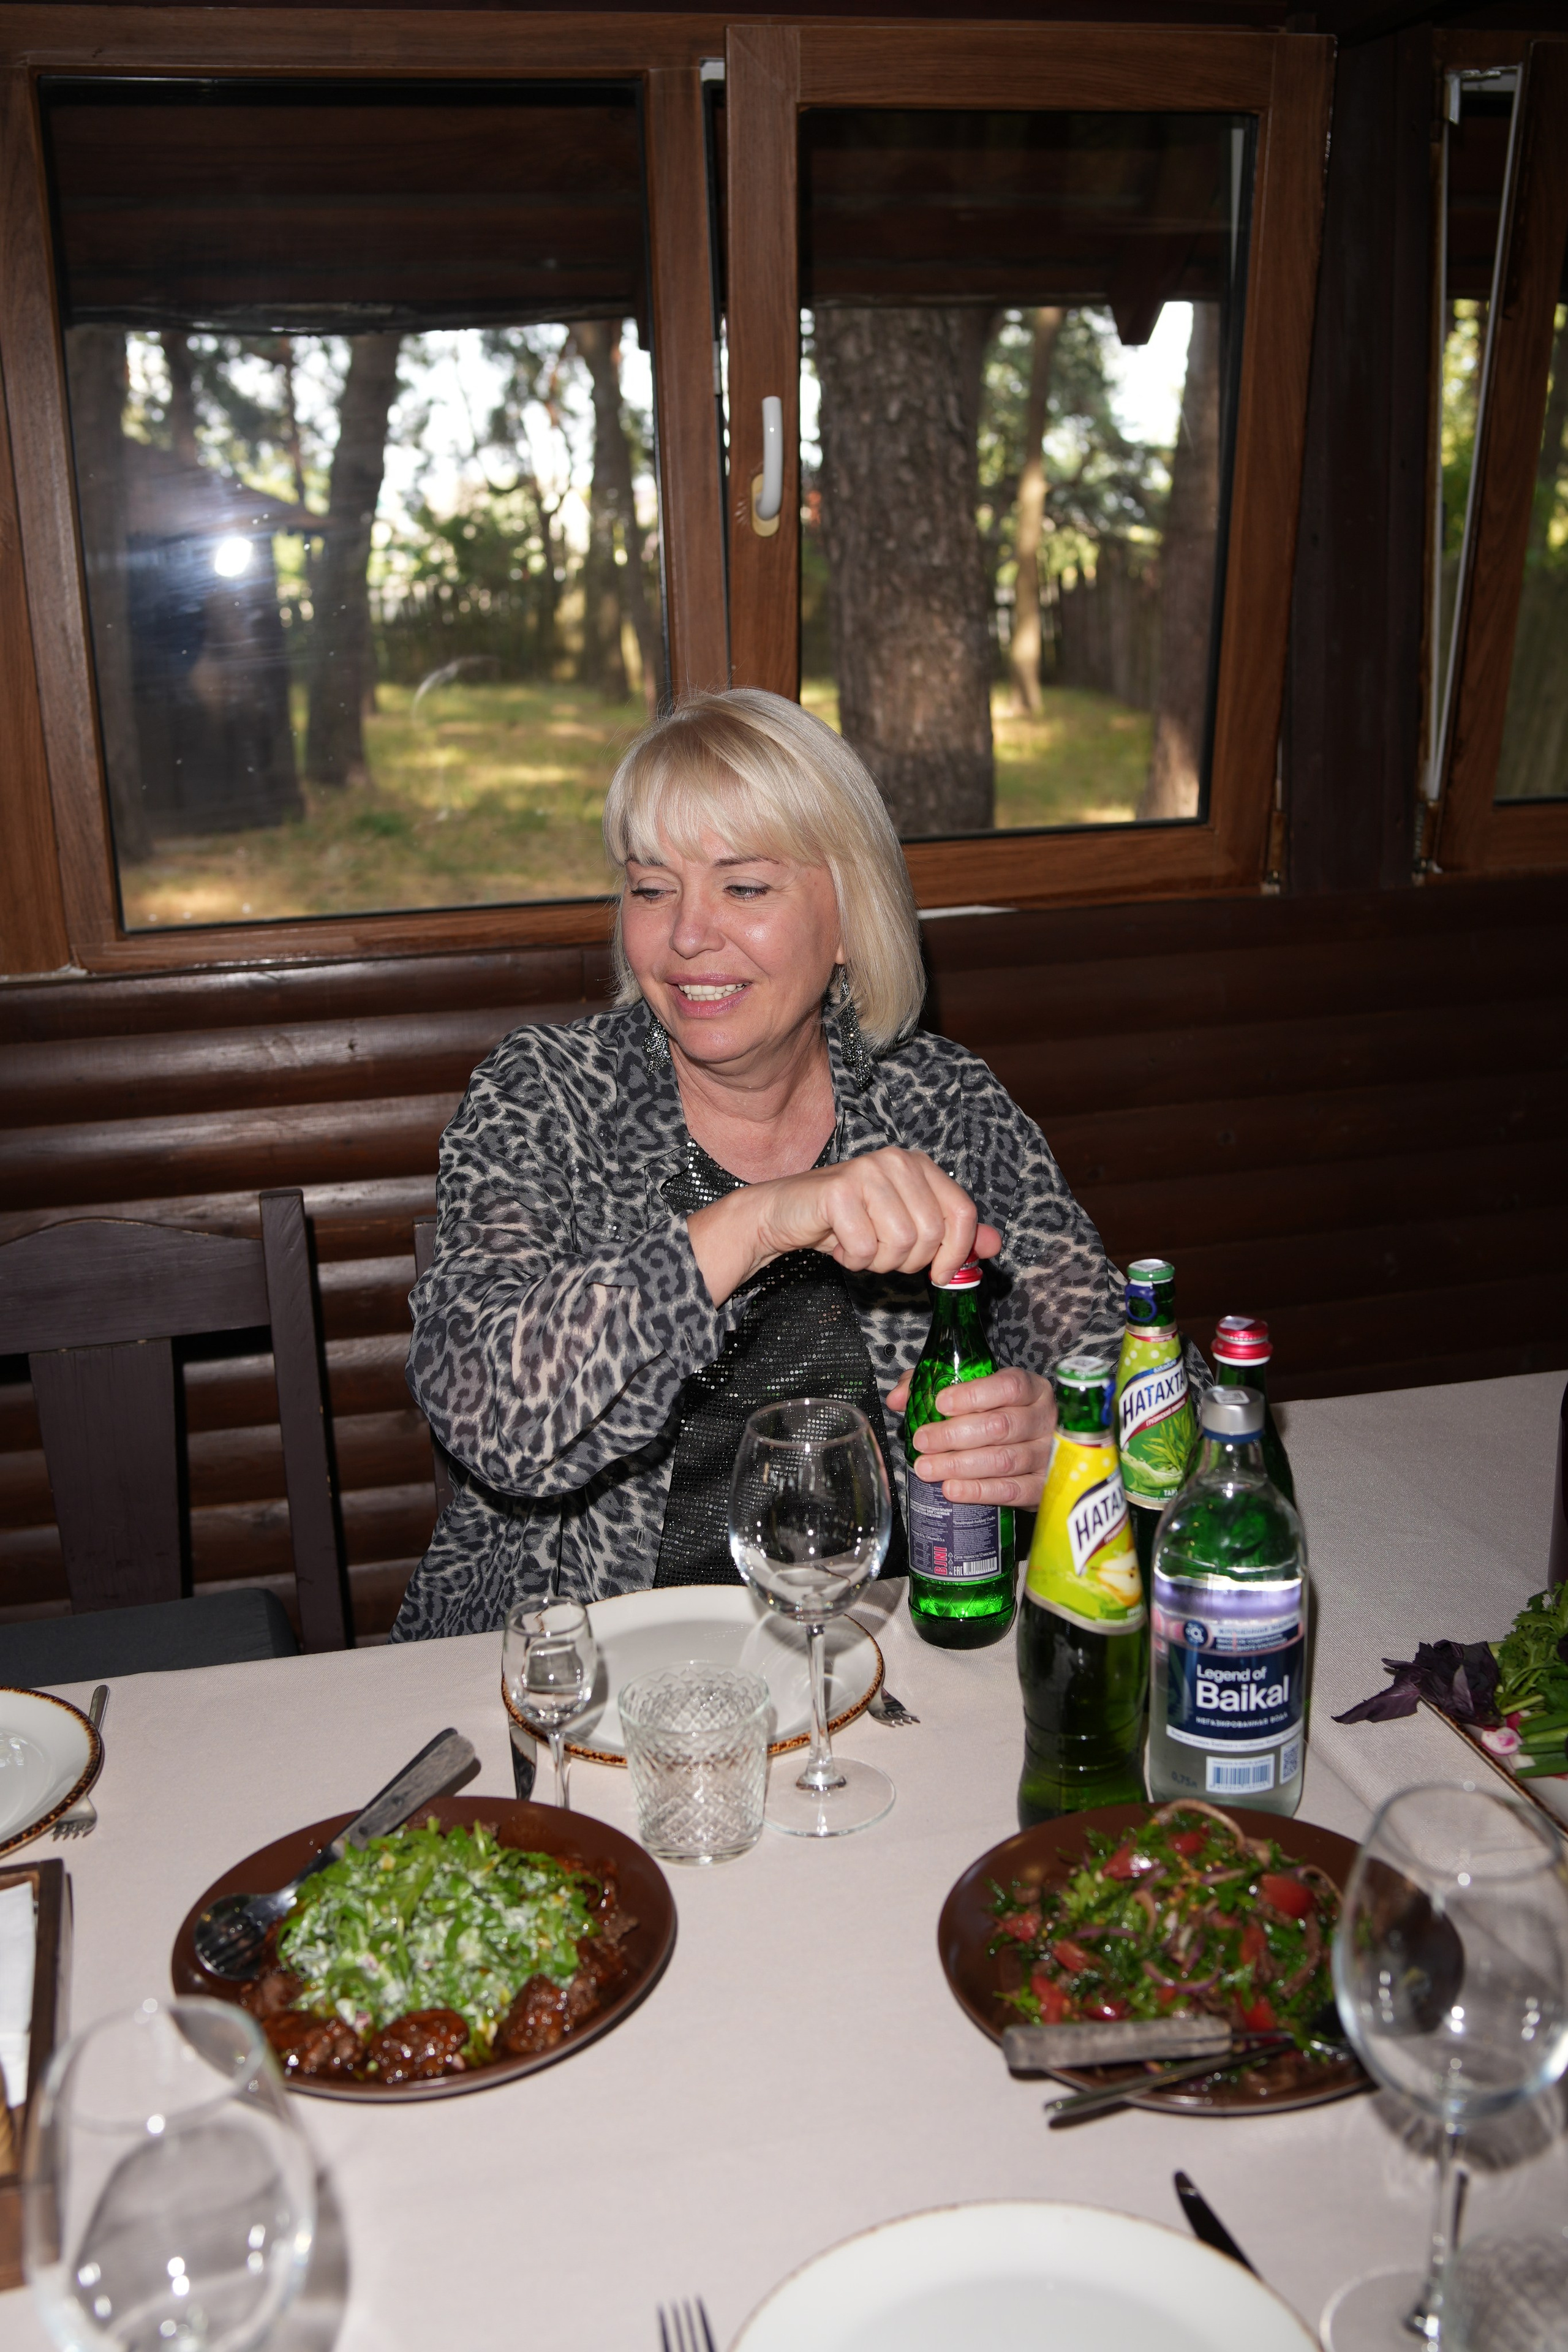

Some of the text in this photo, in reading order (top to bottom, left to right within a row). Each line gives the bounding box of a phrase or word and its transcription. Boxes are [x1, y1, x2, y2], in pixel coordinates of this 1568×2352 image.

[933, 1546, 948, 1575] BJNI
[1196, 1664, 1267, 1683] Legend of
[1196, 1675, 1289, 1712] Baikal
